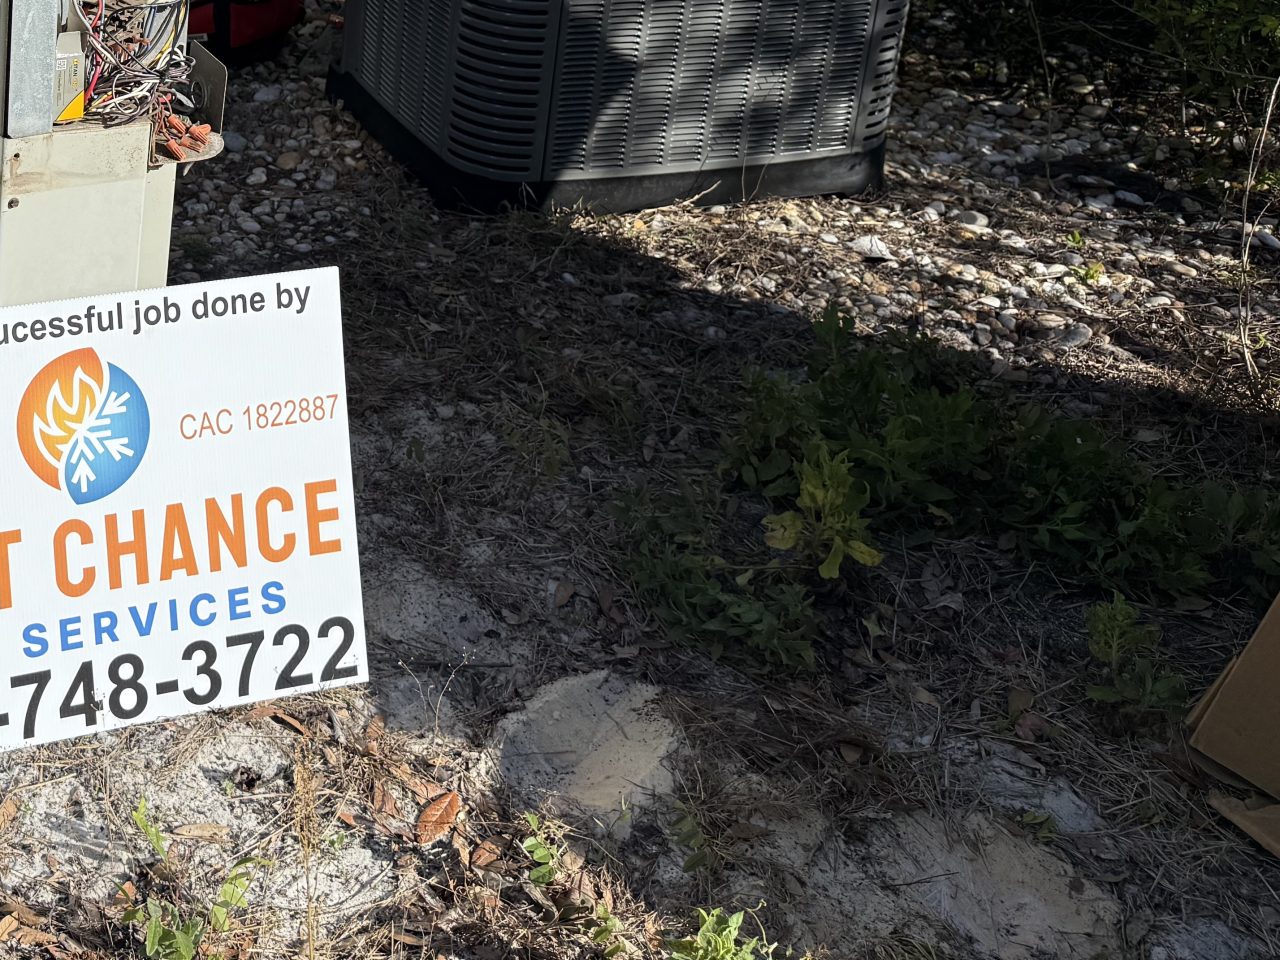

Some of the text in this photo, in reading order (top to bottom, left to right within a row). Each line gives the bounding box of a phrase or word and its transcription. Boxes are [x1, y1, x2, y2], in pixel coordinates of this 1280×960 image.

[132, 296, 181, 335] job
[191, 290, 266, 320] done
[276, 282, 311, 315] by
[179, 393, 339, 440] CAC 1822887
[53, 479, 342, 597] CHANCE
[22, 581, 287, 657] SERVICES
